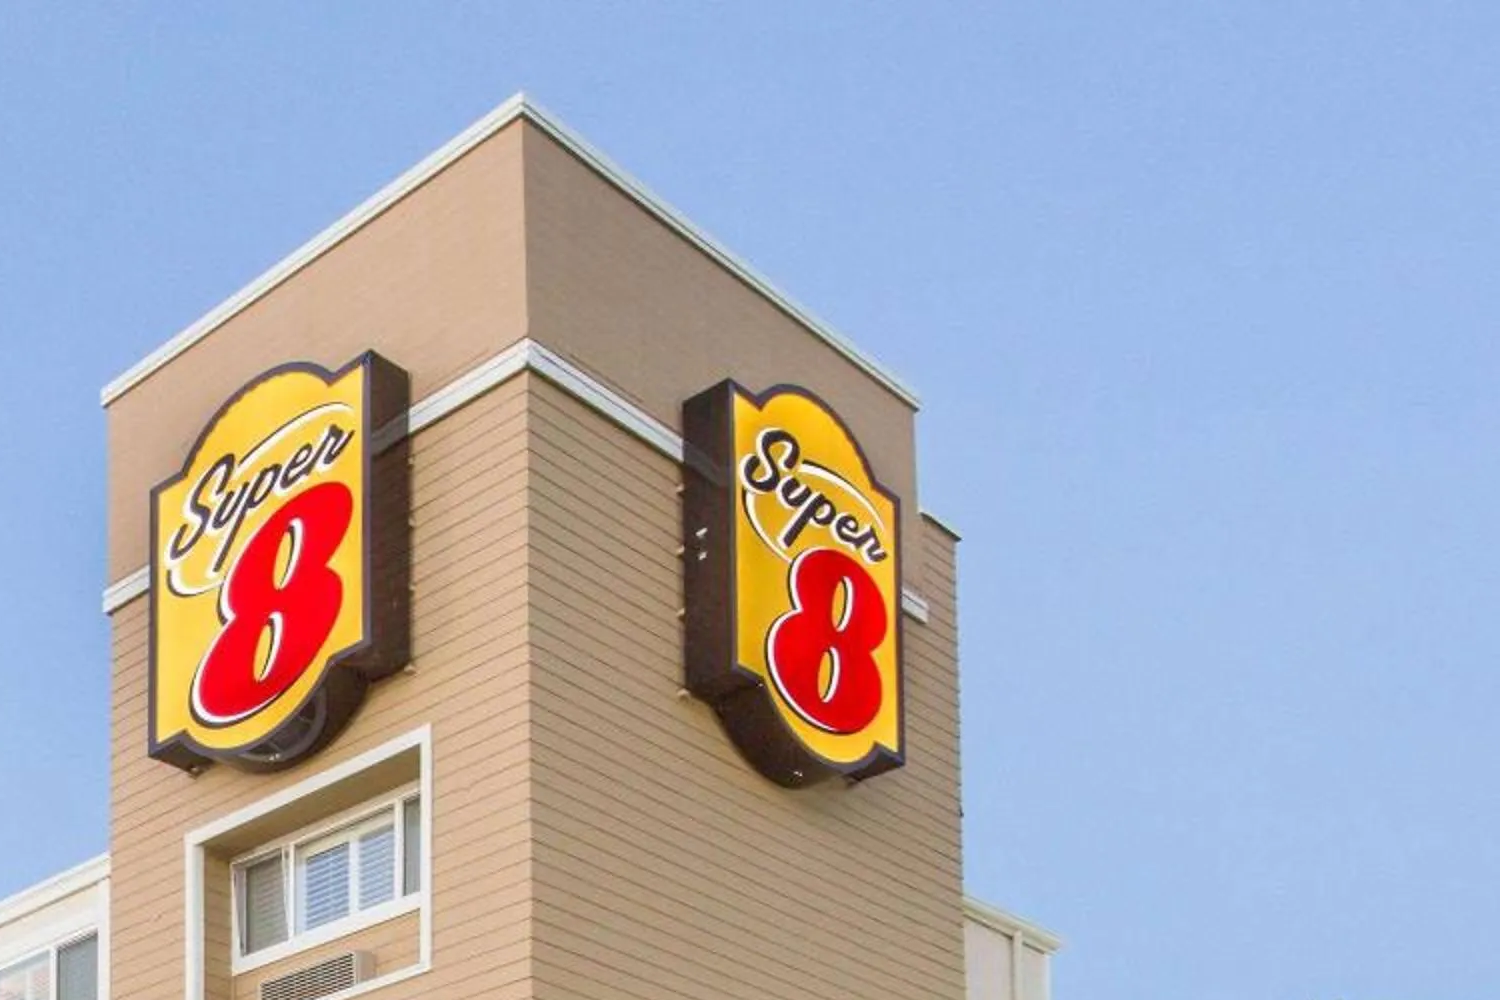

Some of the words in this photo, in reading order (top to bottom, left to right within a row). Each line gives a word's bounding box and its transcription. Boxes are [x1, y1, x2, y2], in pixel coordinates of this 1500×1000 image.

[168, 422, 356, 576] Super
[739, 428, 889, 566] Super
[189, 481, 353, 727] 8
[765, 547, 887, 735] 8
